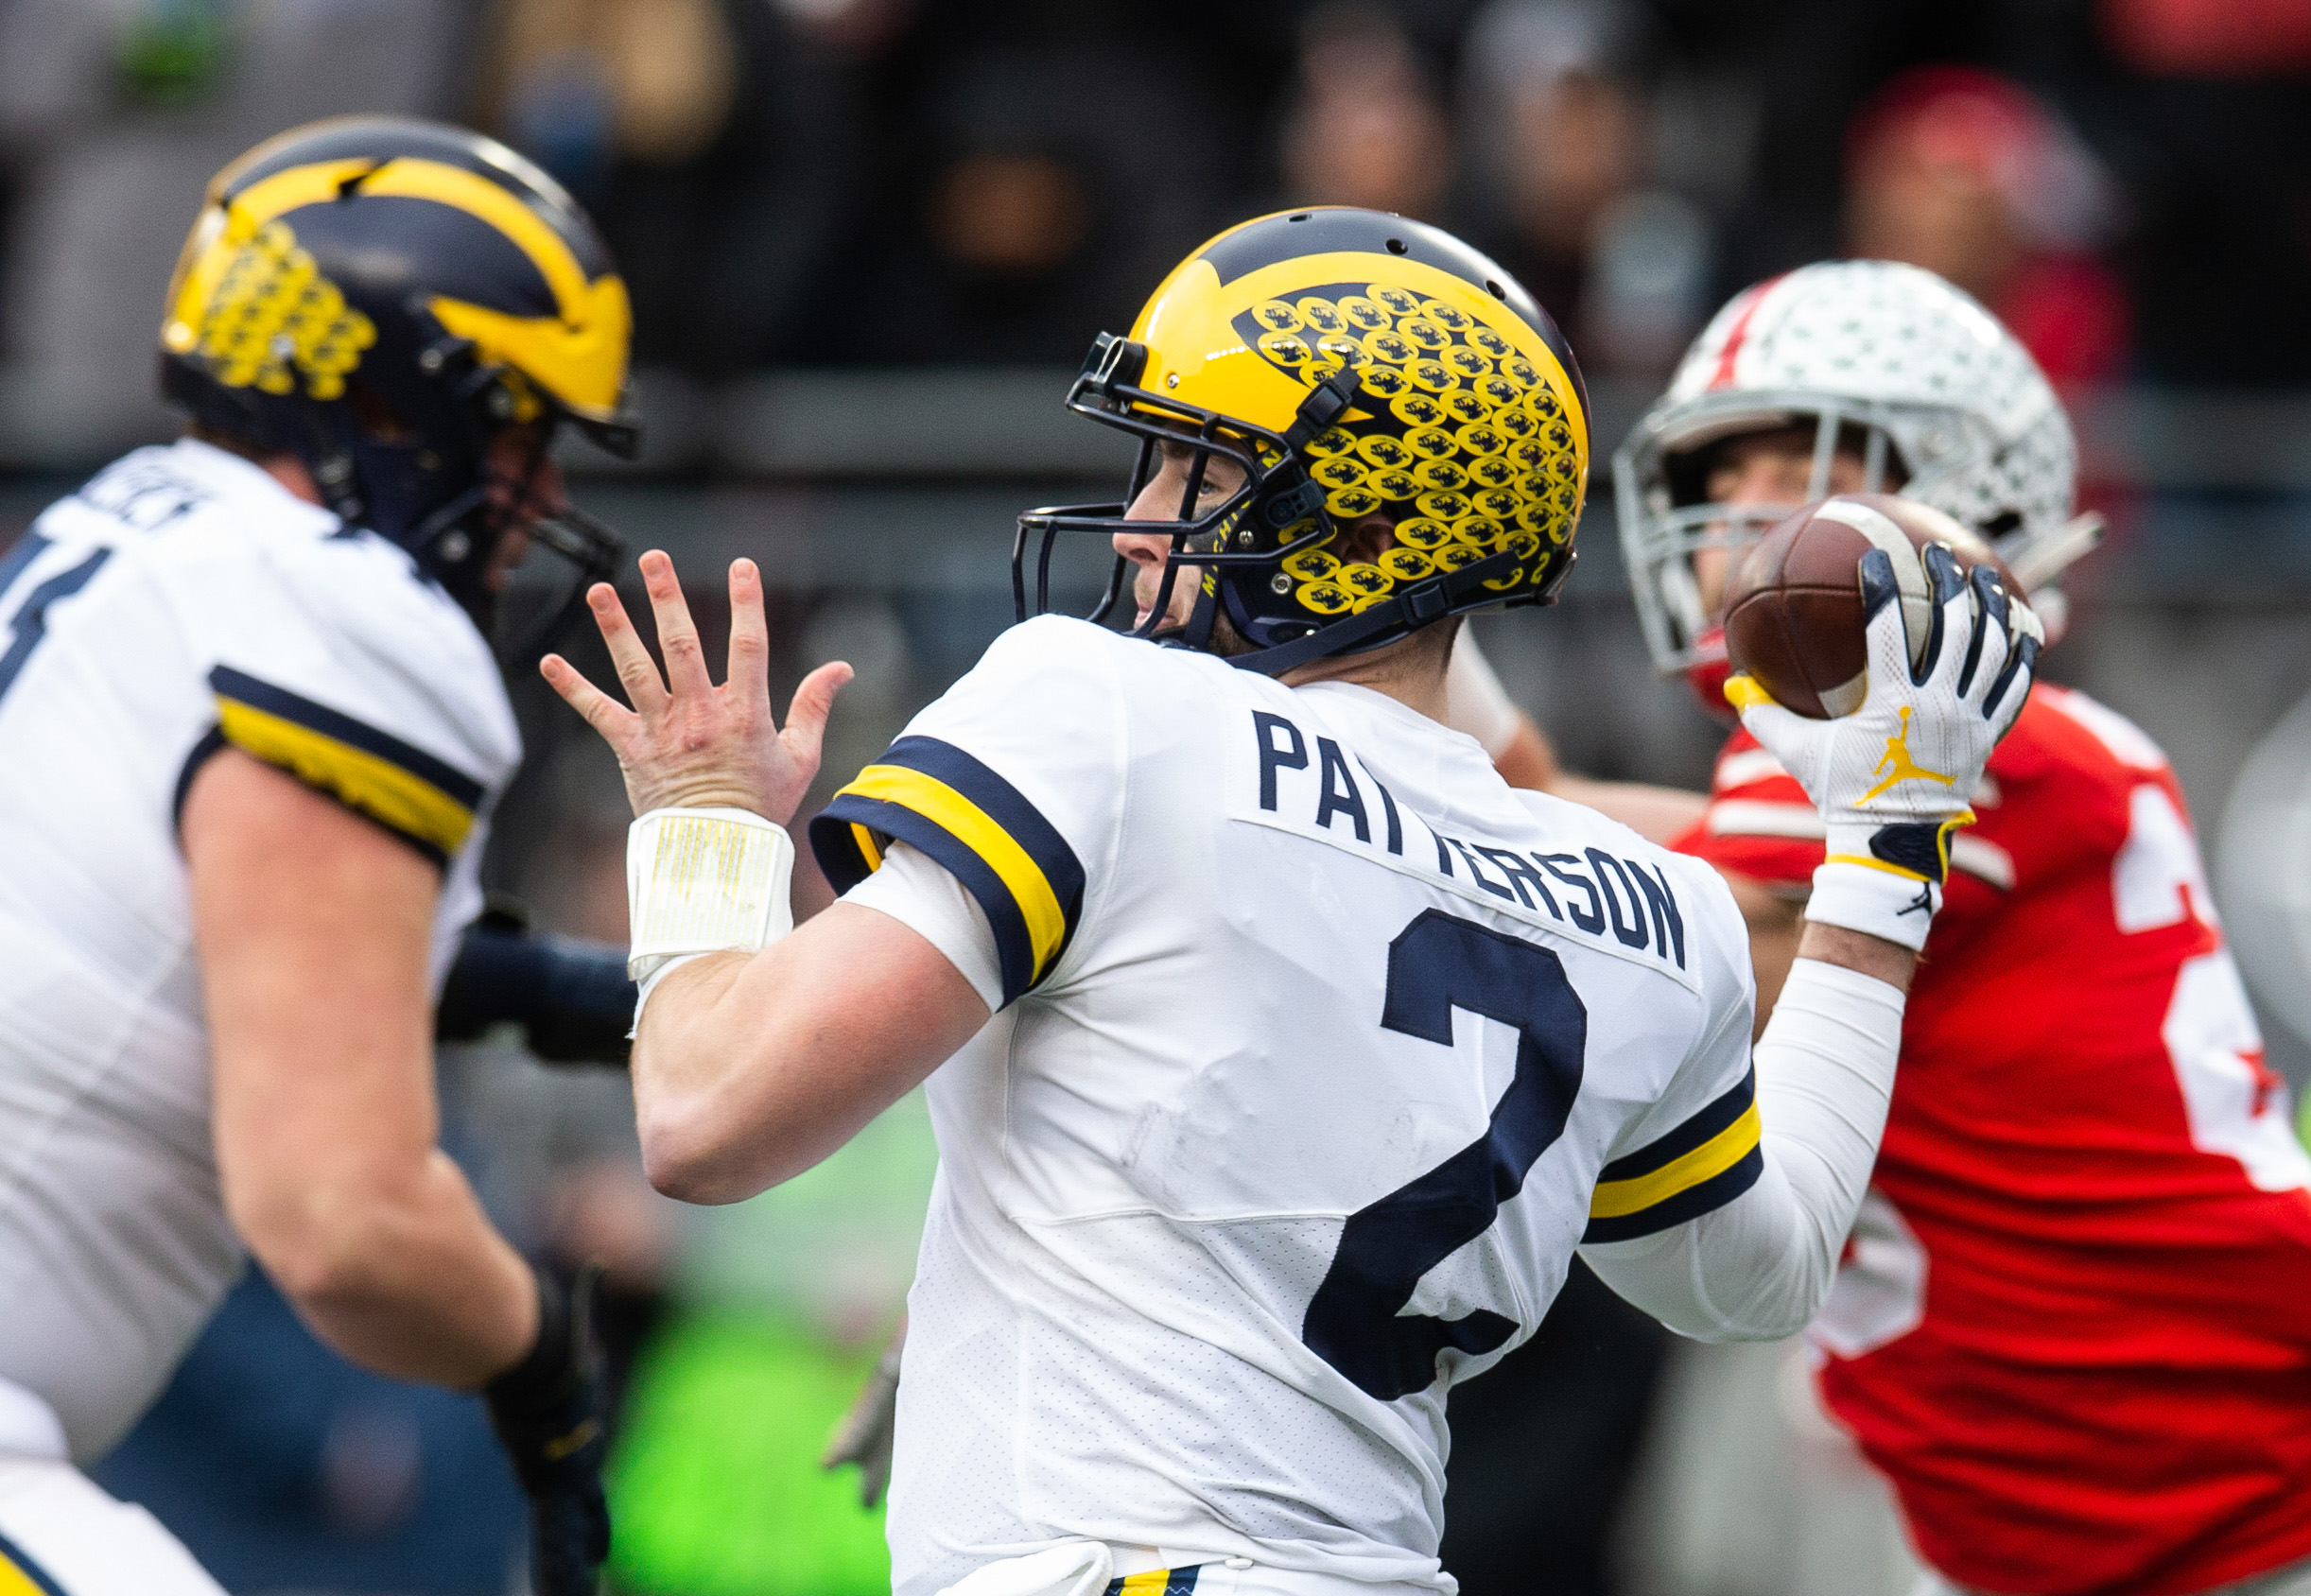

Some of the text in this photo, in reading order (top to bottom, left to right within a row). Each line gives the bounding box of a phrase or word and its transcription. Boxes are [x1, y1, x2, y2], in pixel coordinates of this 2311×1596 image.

[1530, 551, 1551, 584] 2
[1251, 709, 1686, 971] PATTERSON
[1302, 908, 1588, 1401] 2
